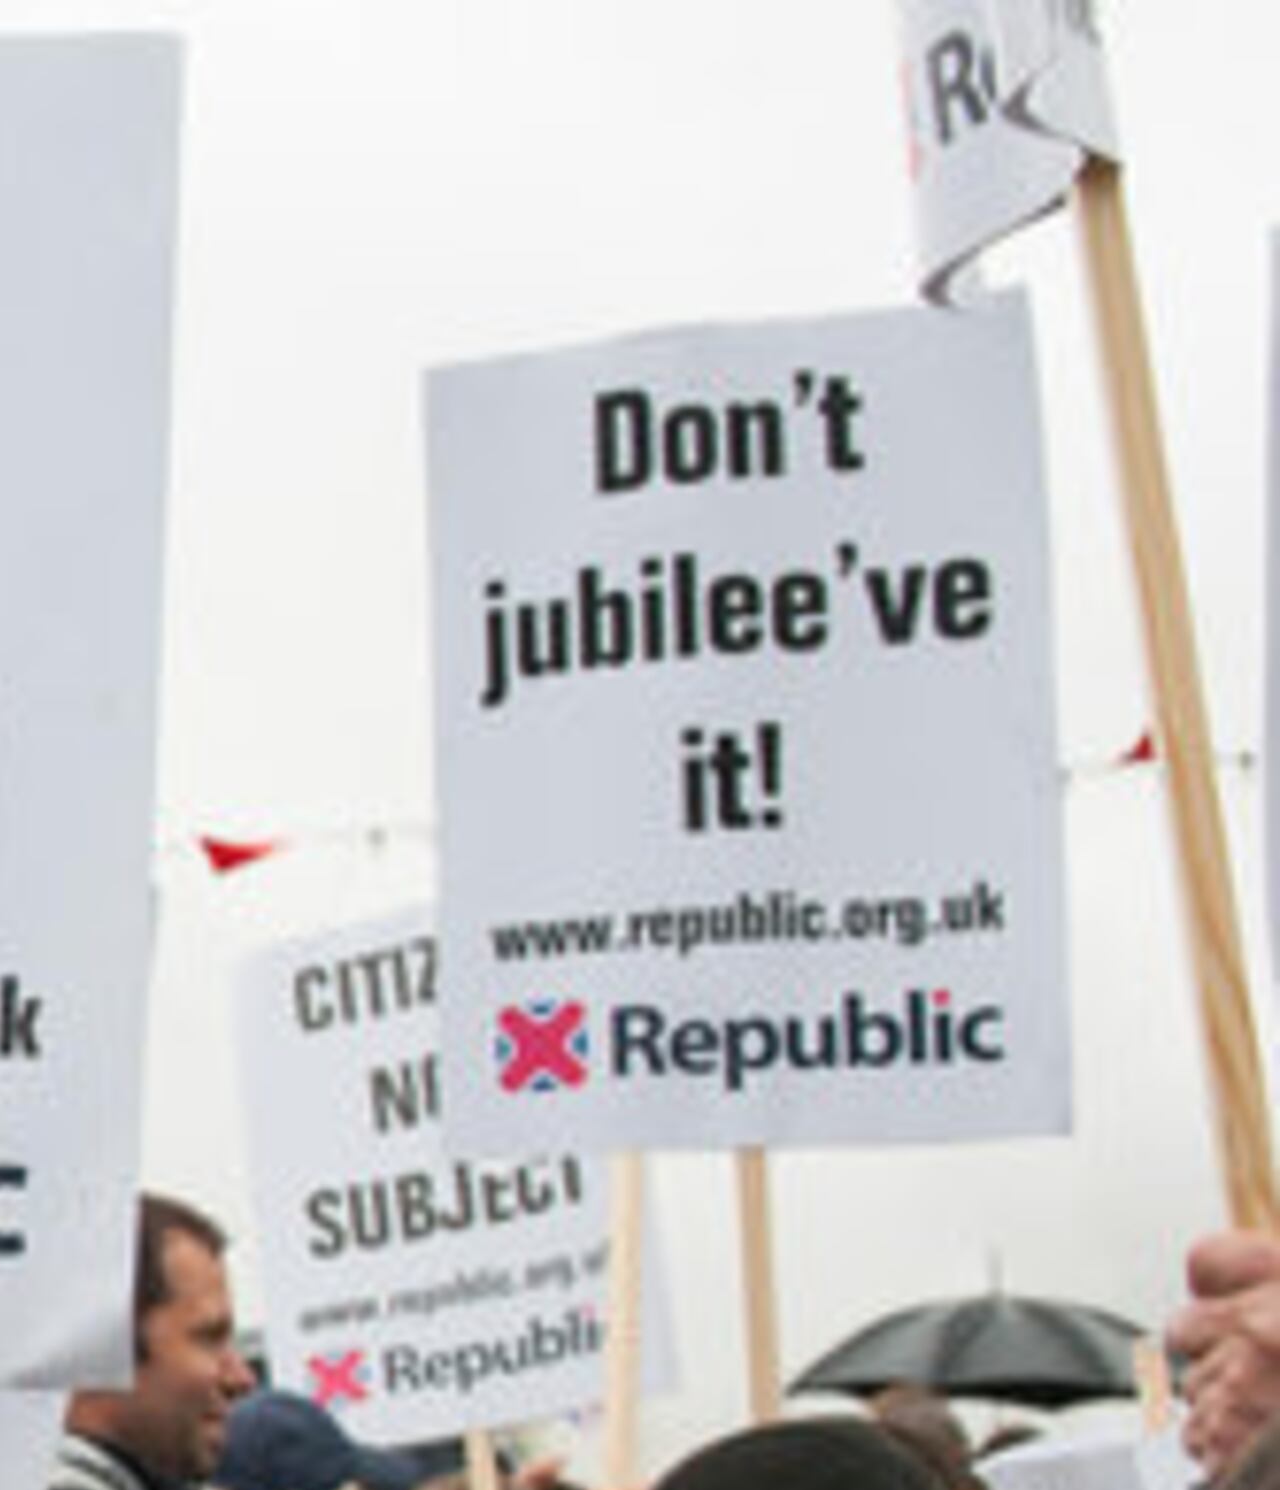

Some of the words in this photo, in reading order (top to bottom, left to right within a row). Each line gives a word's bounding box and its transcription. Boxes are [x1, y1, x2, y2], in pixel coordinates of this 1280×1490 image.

[928, 30, 1000, 147] R
[680, 722, 783, 832] it!
[490, 882, 1005, 962] www.republic.org.uk
[610, 988, 1006, 1091] Republic
